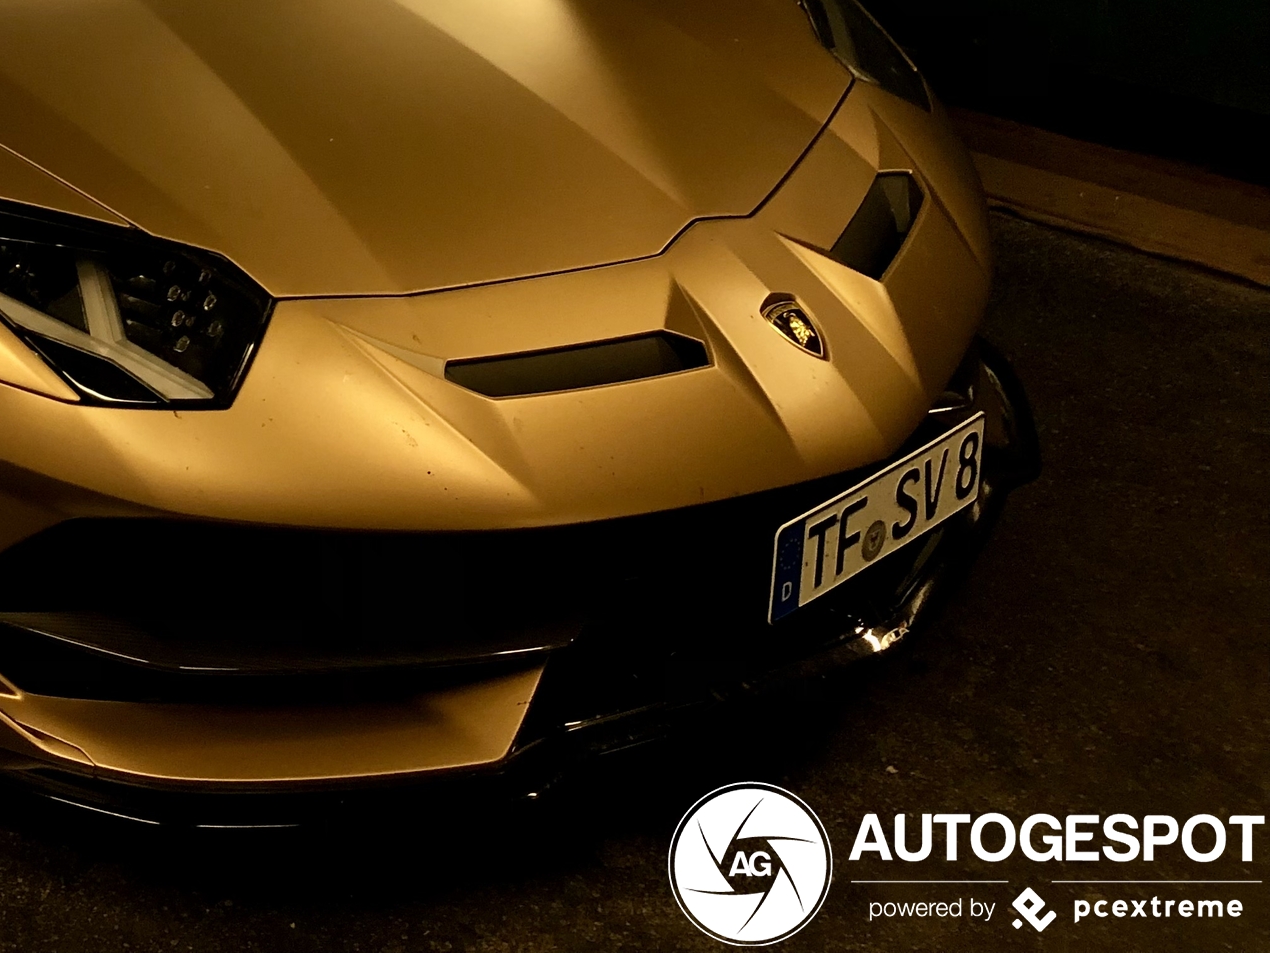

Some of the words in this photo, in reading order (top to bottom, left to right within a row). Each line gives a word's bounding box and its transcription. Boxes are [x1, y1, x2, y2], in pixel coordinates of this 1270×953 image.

[808, 496, 868, 589] TF
[891, 448, 950, 540] SV
[956, 431, 979, 500] 8
[781, 581, 792, 603] D
